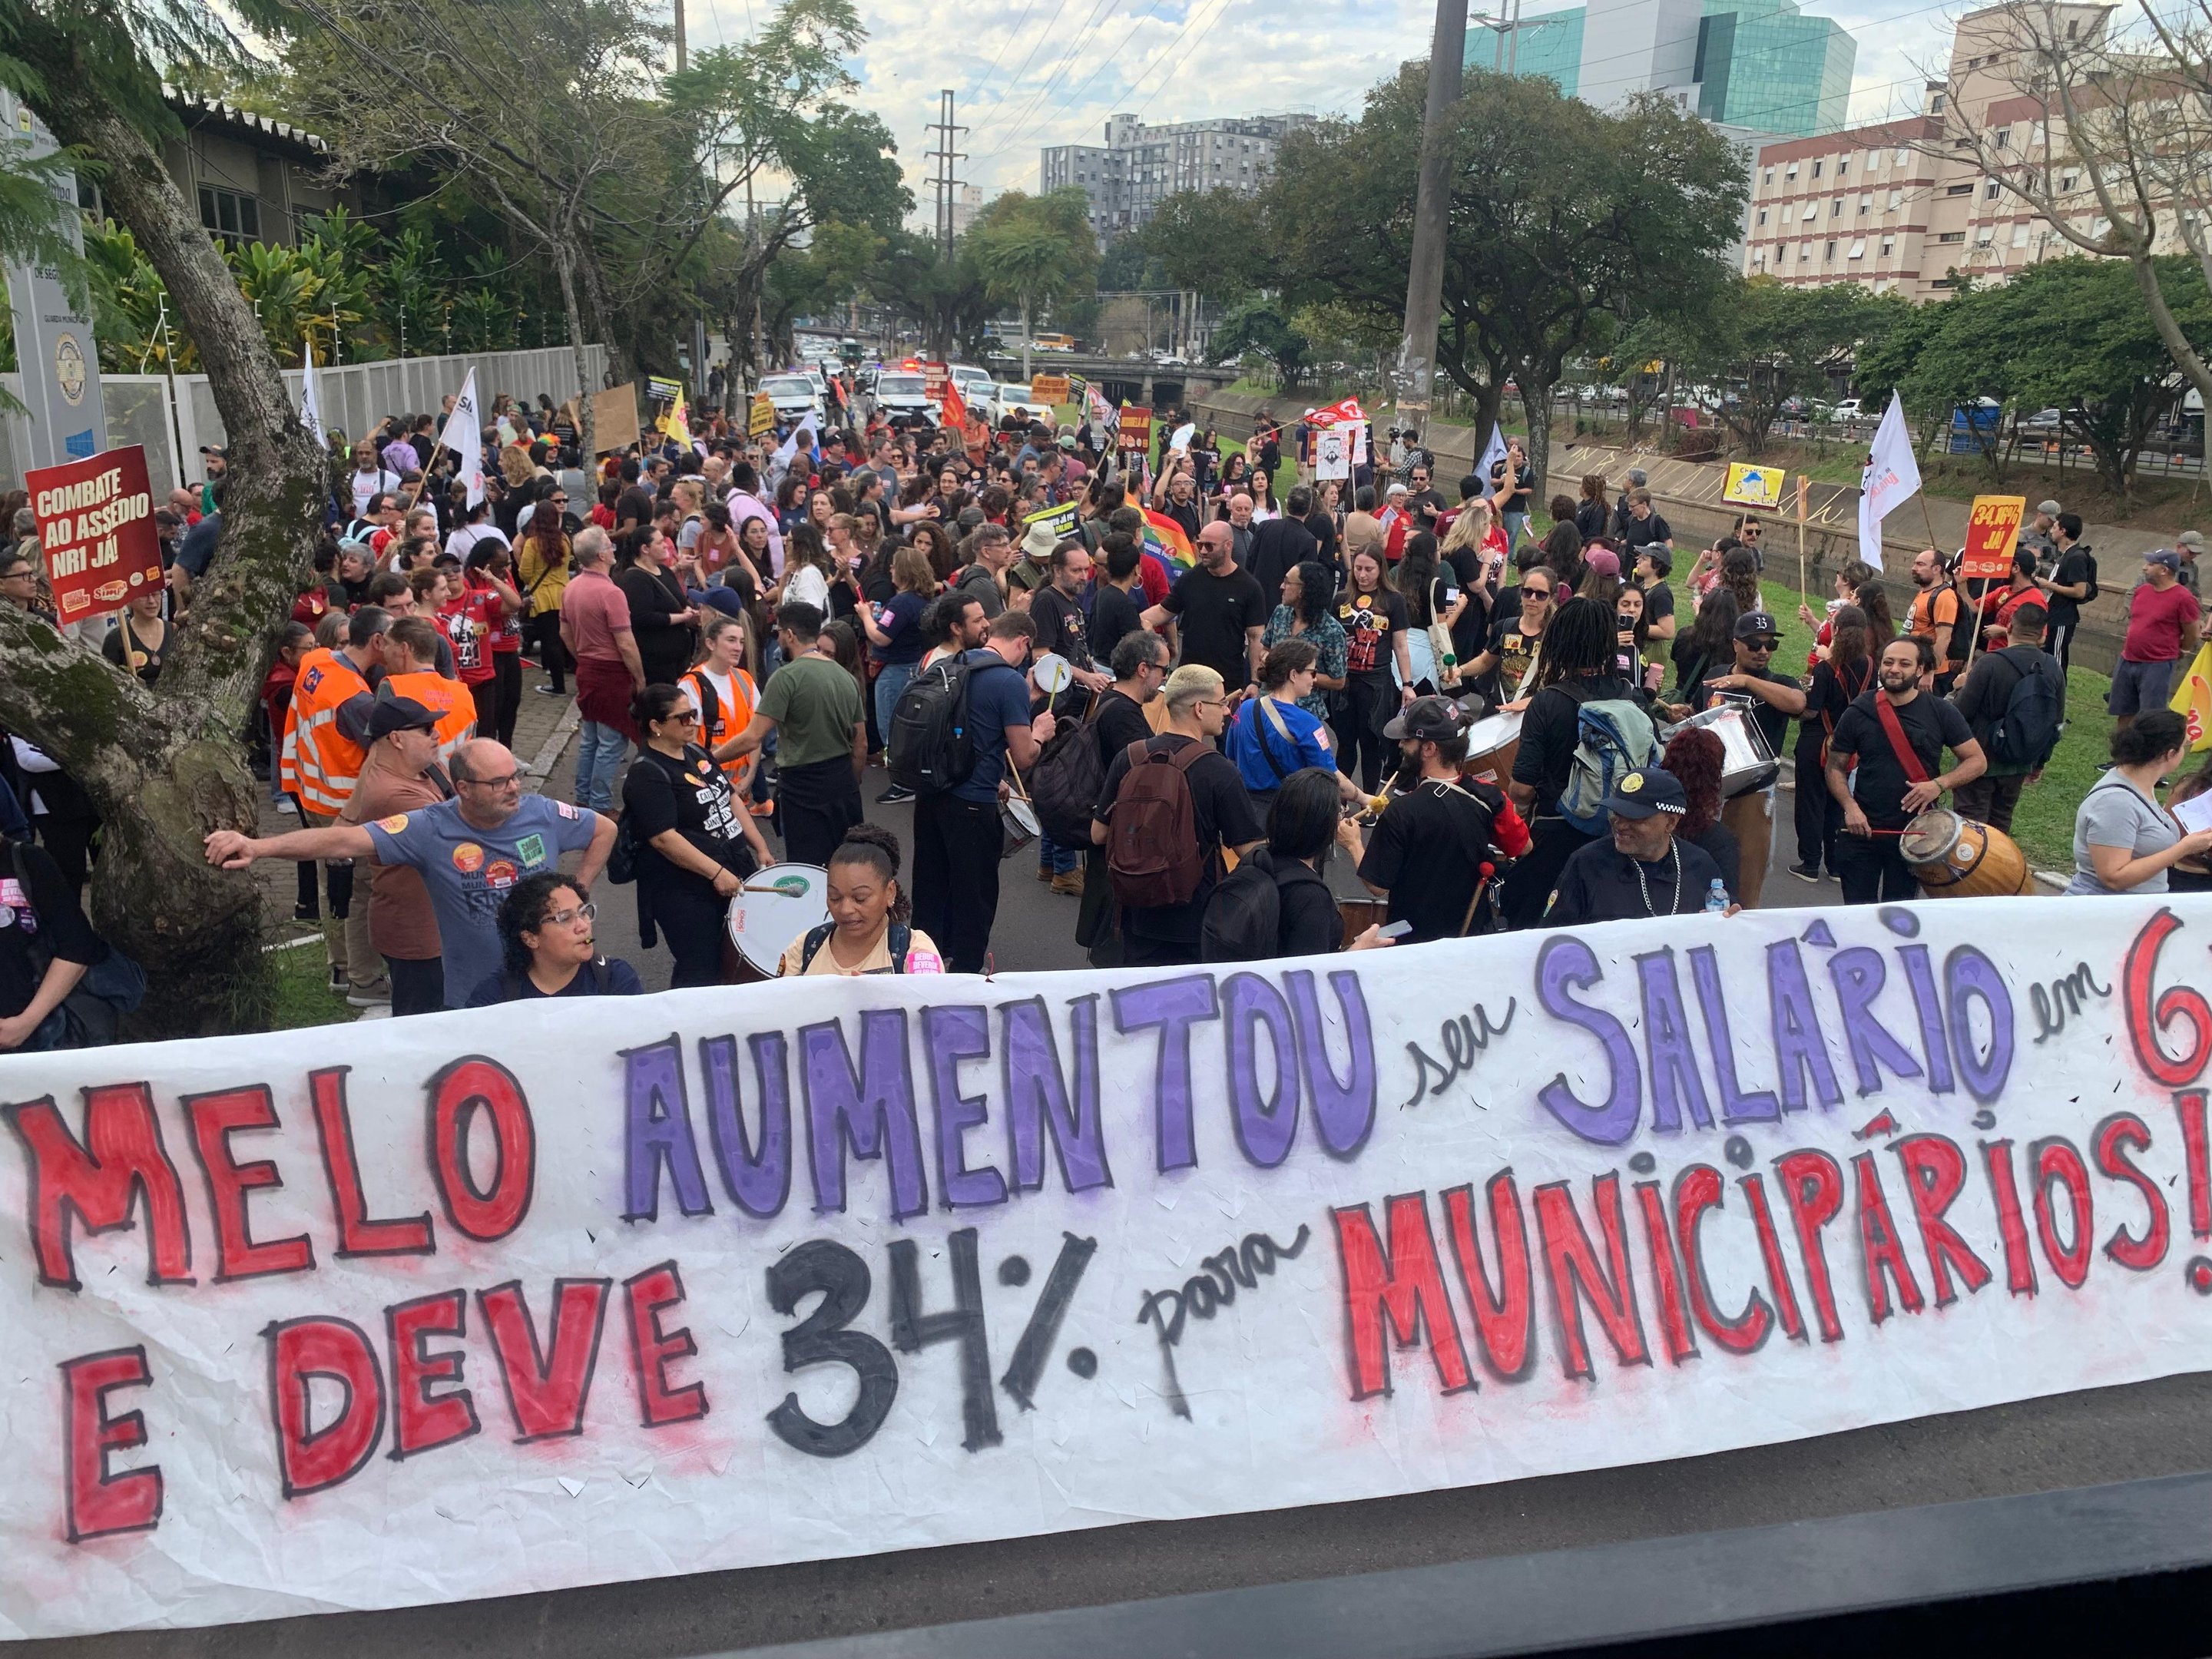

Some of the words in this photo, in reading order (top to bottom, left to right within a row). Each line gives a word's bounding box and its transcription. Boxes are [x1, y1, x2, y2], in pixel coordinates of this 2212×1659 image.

[37, 467, 122, 518] COMBATE
[45, 518, 71, 550] AO
[76, 492, 149, 541] ASSÉDIO
[51, 545, 88, 580] NR1
[91, 533, 119, 568] JÁ!
[2, 1054, 536, 1292] MELO
[617, 969, 1377, 1227] AUMENTOU
[1400, 995, 1516, 1111] seu
[2030, 961, 2112, 1045] em
[58, 1344, 164, 1542] E
[260, 1260, 710, 1500] DEVE
[767, 1228, 1097, 1458] 34%
[1138, 1223, 1310, 1422] para
